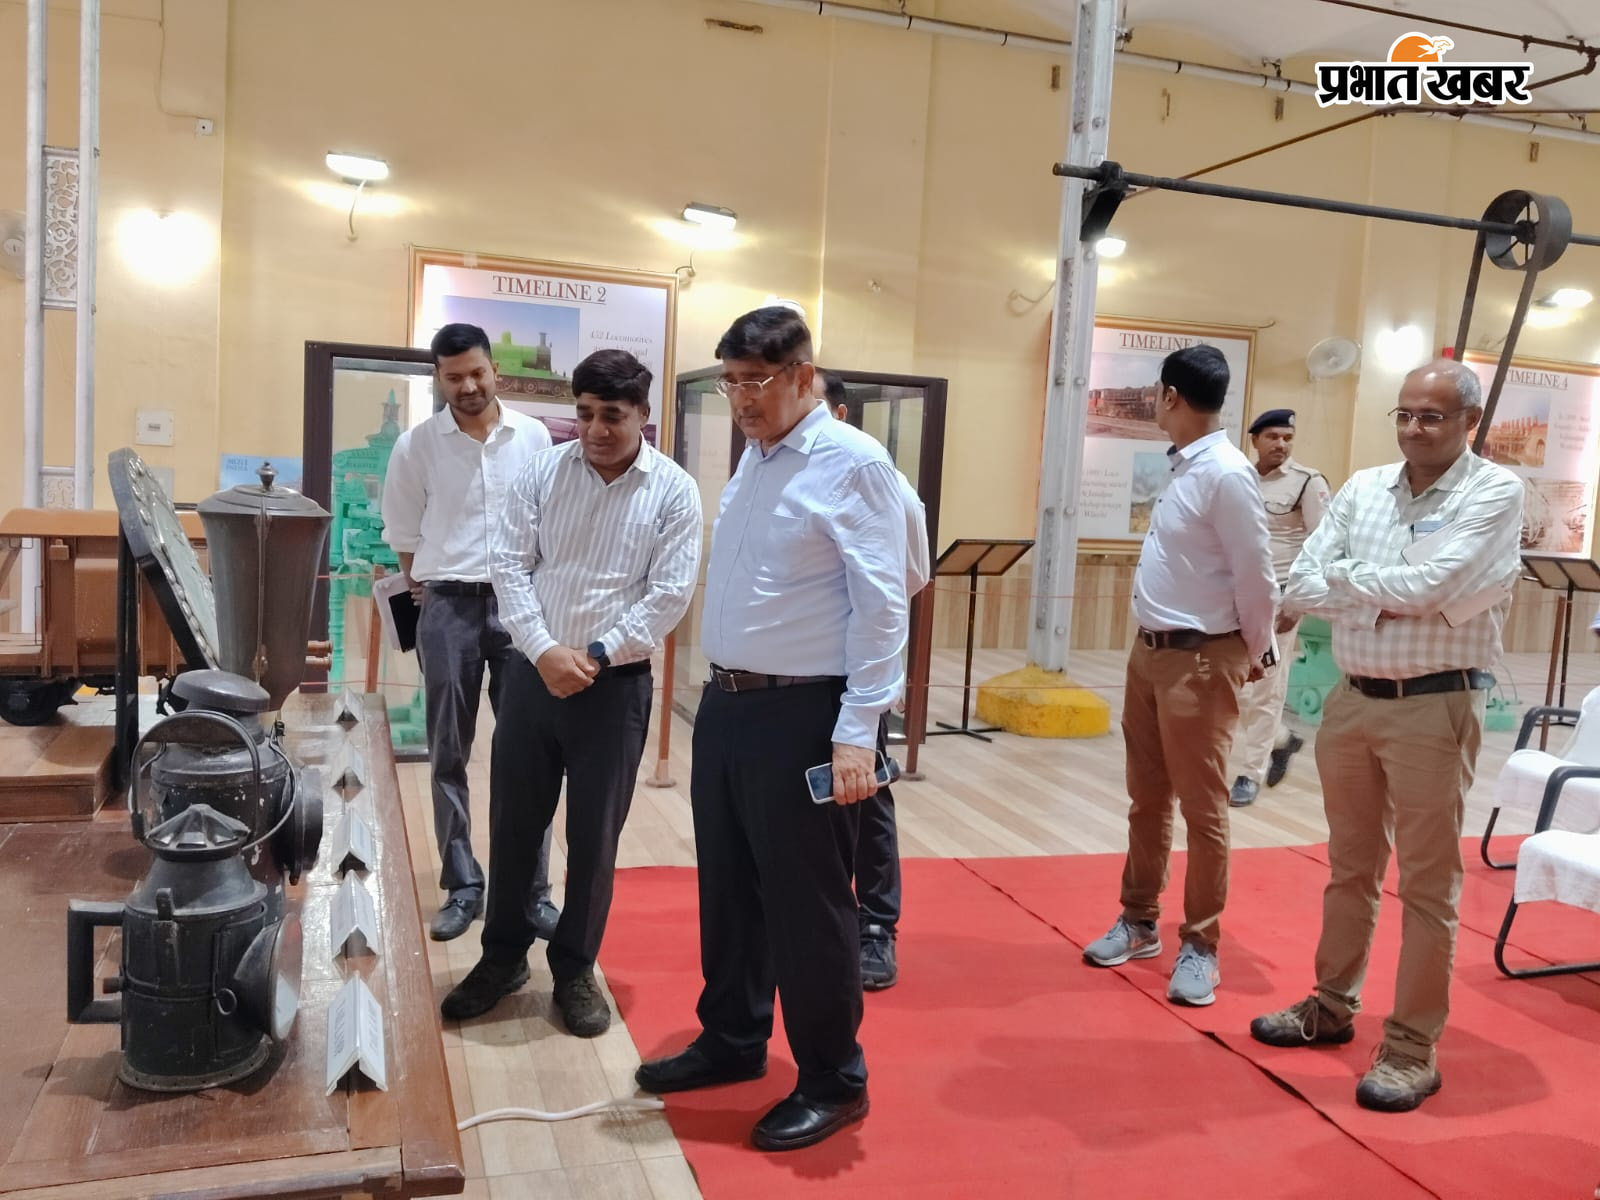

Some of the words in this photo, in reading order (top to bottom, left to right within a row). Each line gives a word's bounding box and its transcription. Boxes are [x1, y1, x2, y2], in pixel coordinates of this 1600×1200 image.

[493, 275, 592, 301] TIMELINE
[597, 286, 607, 302] 2
[1120, 332, 1192, 351] TIMELINE
[1508, 369, 1560, 388] IMELINE
[1562, 375, 1568, 390] 4
